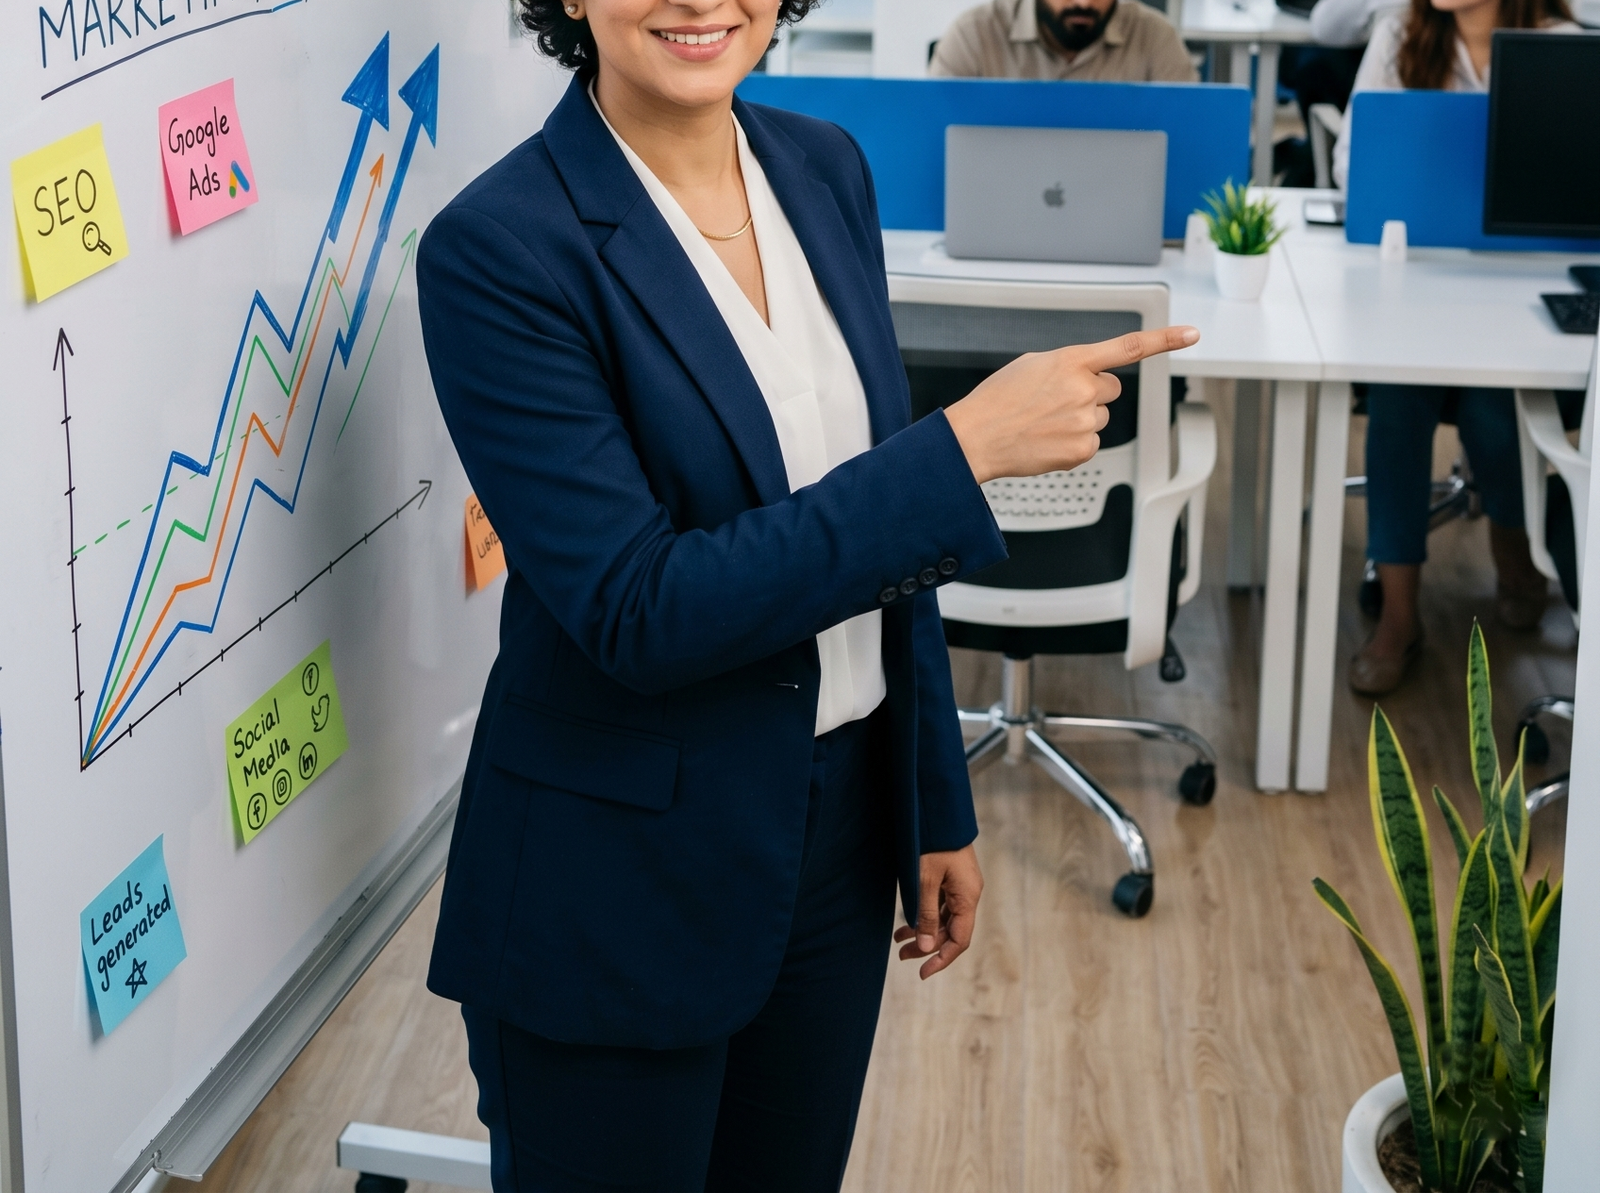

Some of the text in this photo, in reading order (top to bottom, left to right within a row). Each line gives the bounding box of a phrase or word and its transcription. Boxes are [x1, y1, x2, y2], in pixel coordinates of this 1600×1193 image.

[168, 106, 230, 157] Google
[34, 168, 97, 237] SEO
[189, 163, 221, 201] Ads
[233, 697, 281, 759] Social
[91, 880, 143, 946] Leads
[97, 883, 172, 992] generated
